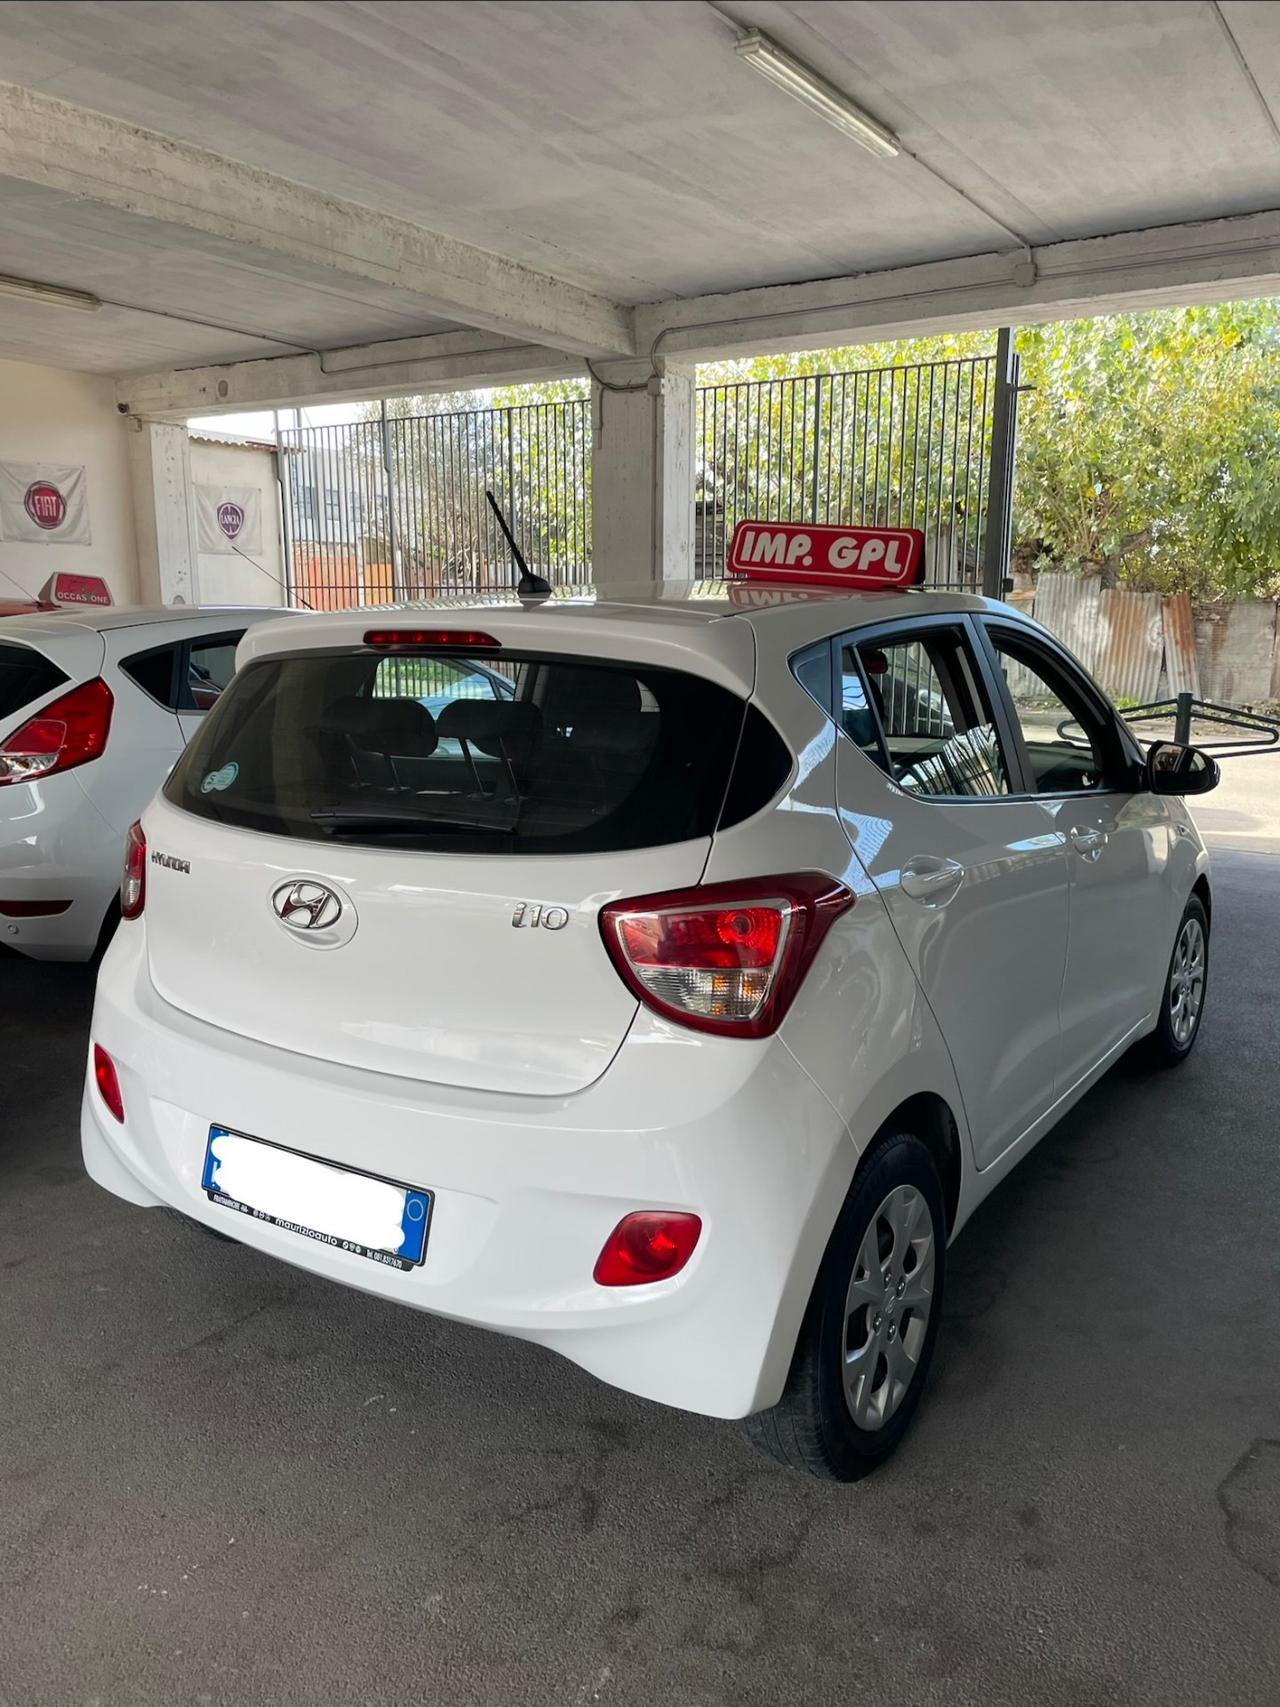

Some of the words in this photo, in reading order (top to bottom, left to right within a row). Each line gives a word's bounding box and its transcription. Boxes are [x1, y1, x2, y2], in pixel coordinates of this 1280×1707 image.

[34, 495, 57, 517] FIAT
[740, 531, 813, 566] IMP.
[828, 536, 902, 573] GPL
[57, 591, 109, 604] OCCASONE
[512, 901, 569, 930] i10
